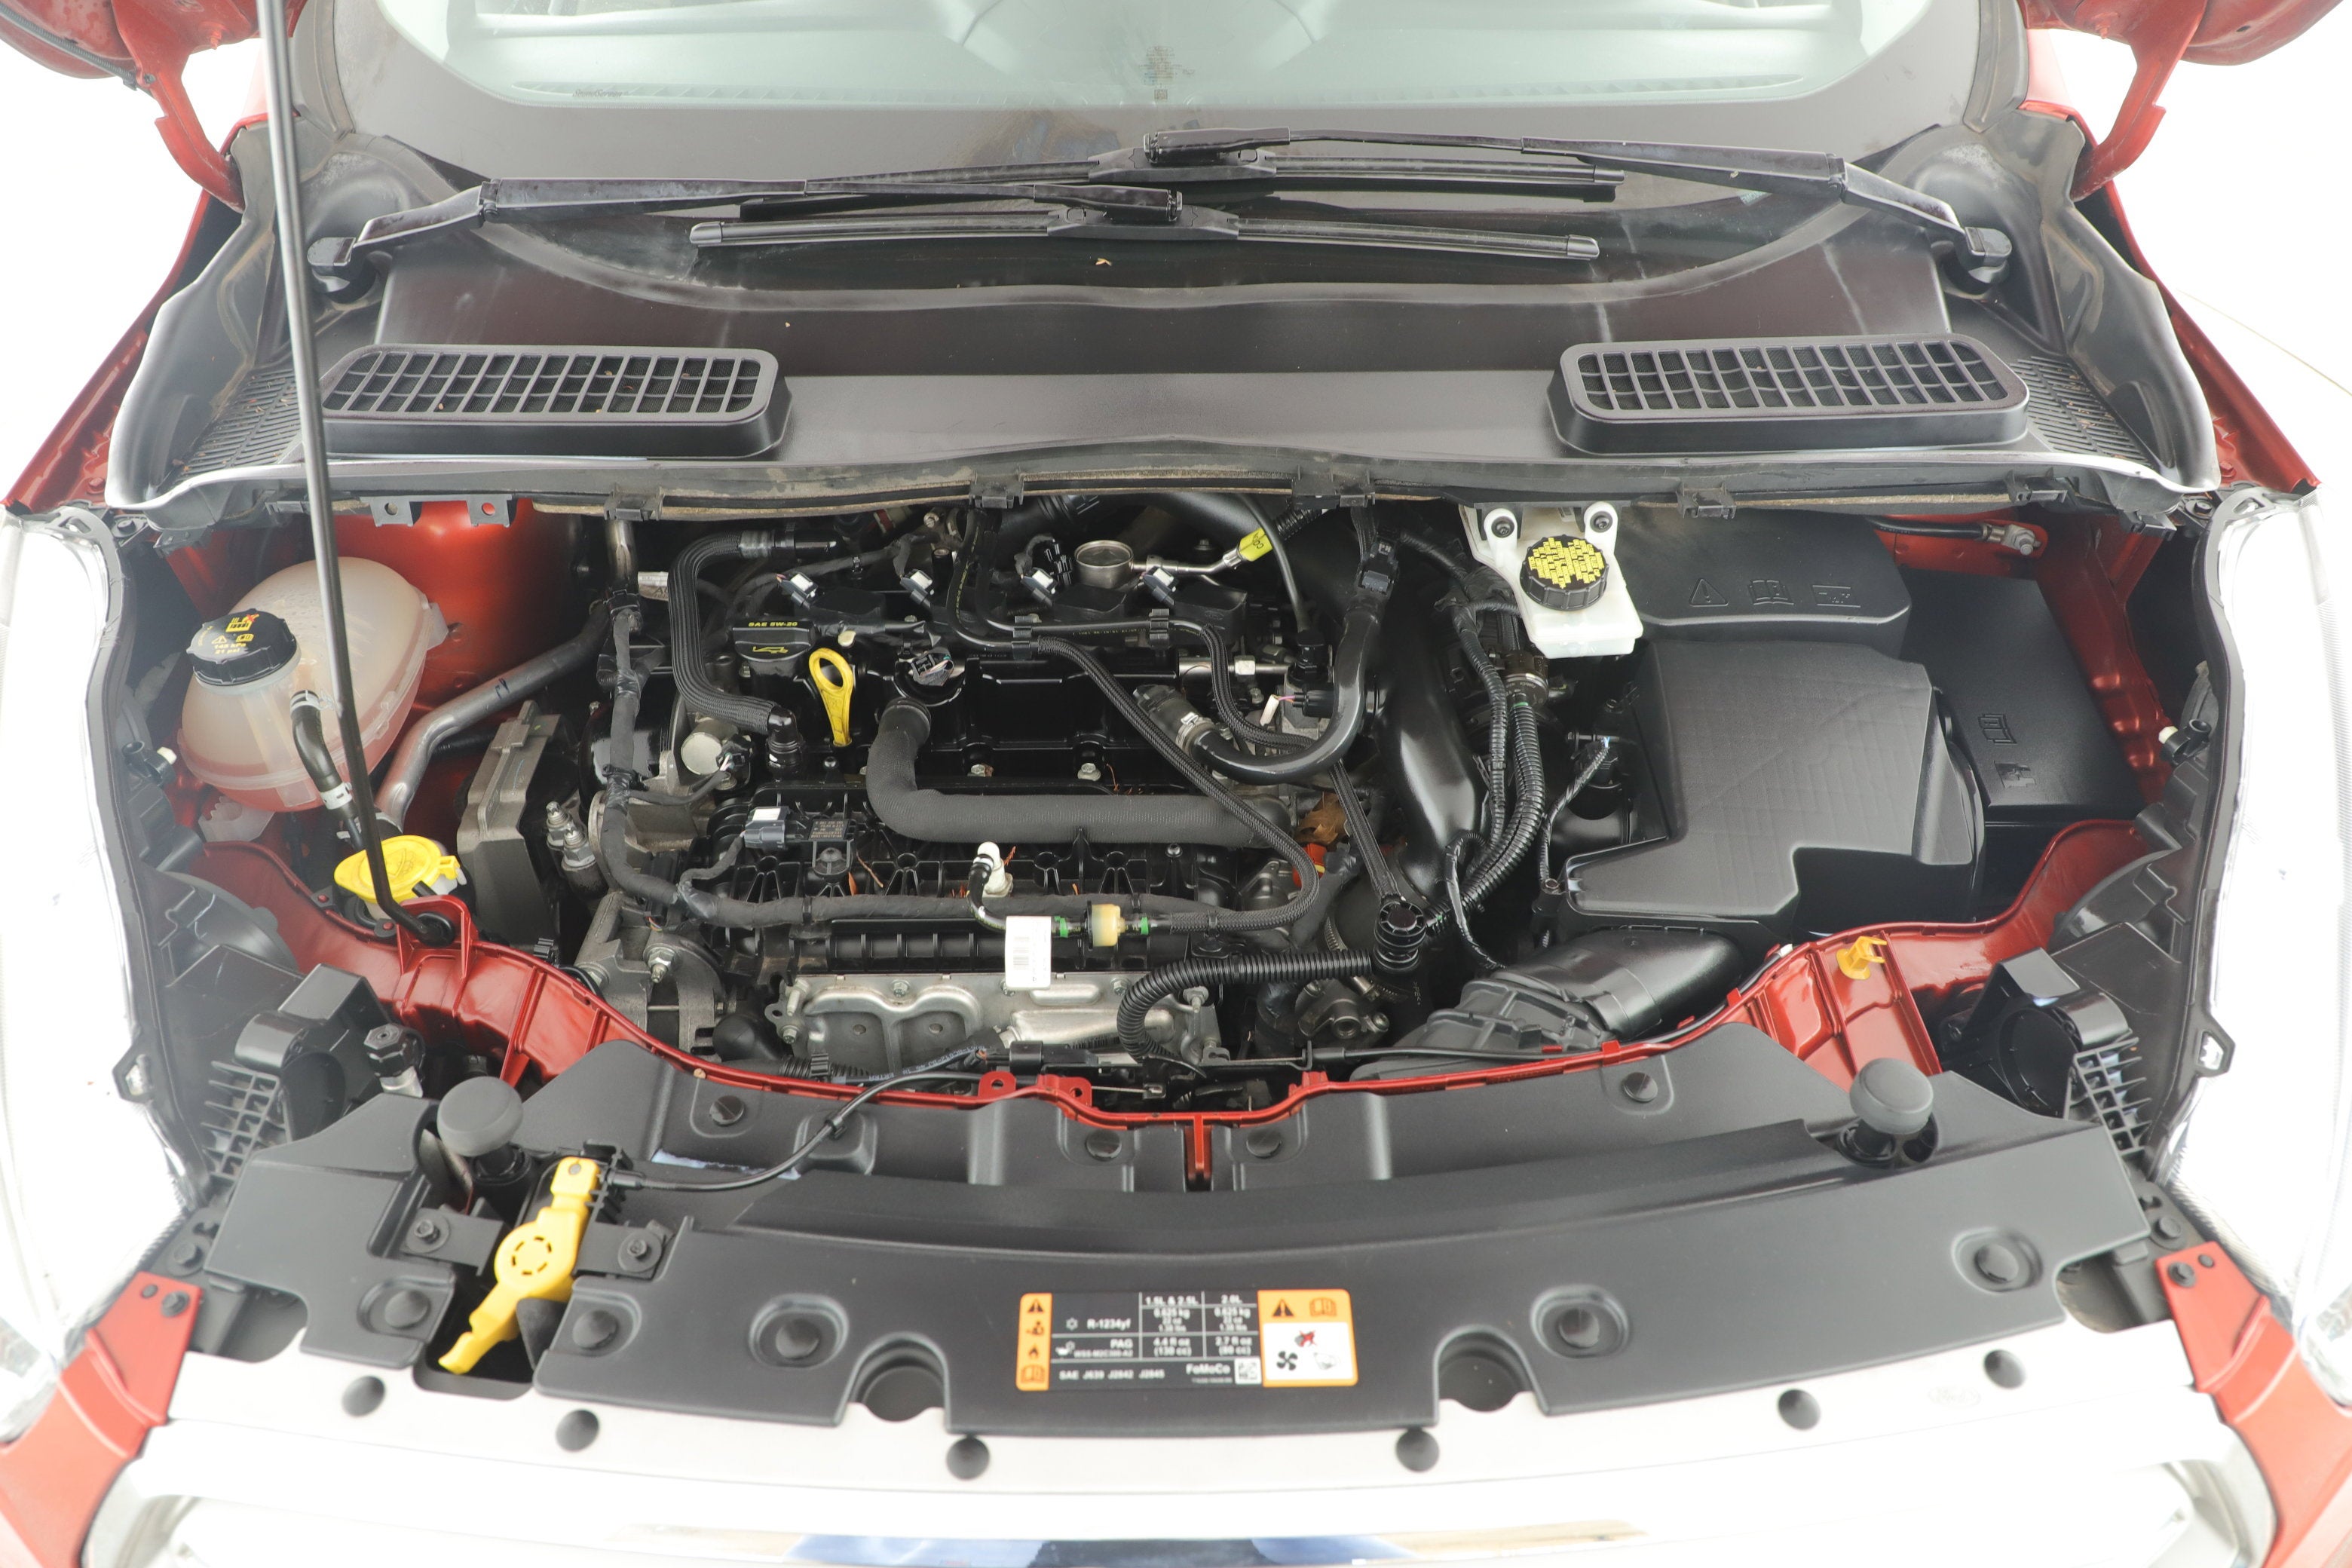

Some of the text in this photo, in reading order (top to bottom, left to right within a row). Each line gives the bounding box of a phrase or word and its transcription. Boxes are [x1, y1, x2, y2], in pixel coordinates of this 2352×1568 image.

[1086, 1318, 1131, 1331] R-1234yf
[1110, 1339, 1133, 1349] PAG
[1186, 1363, 1230, 1374] FoMoCo
[1059, 1370, 1079, 1380] SAE
